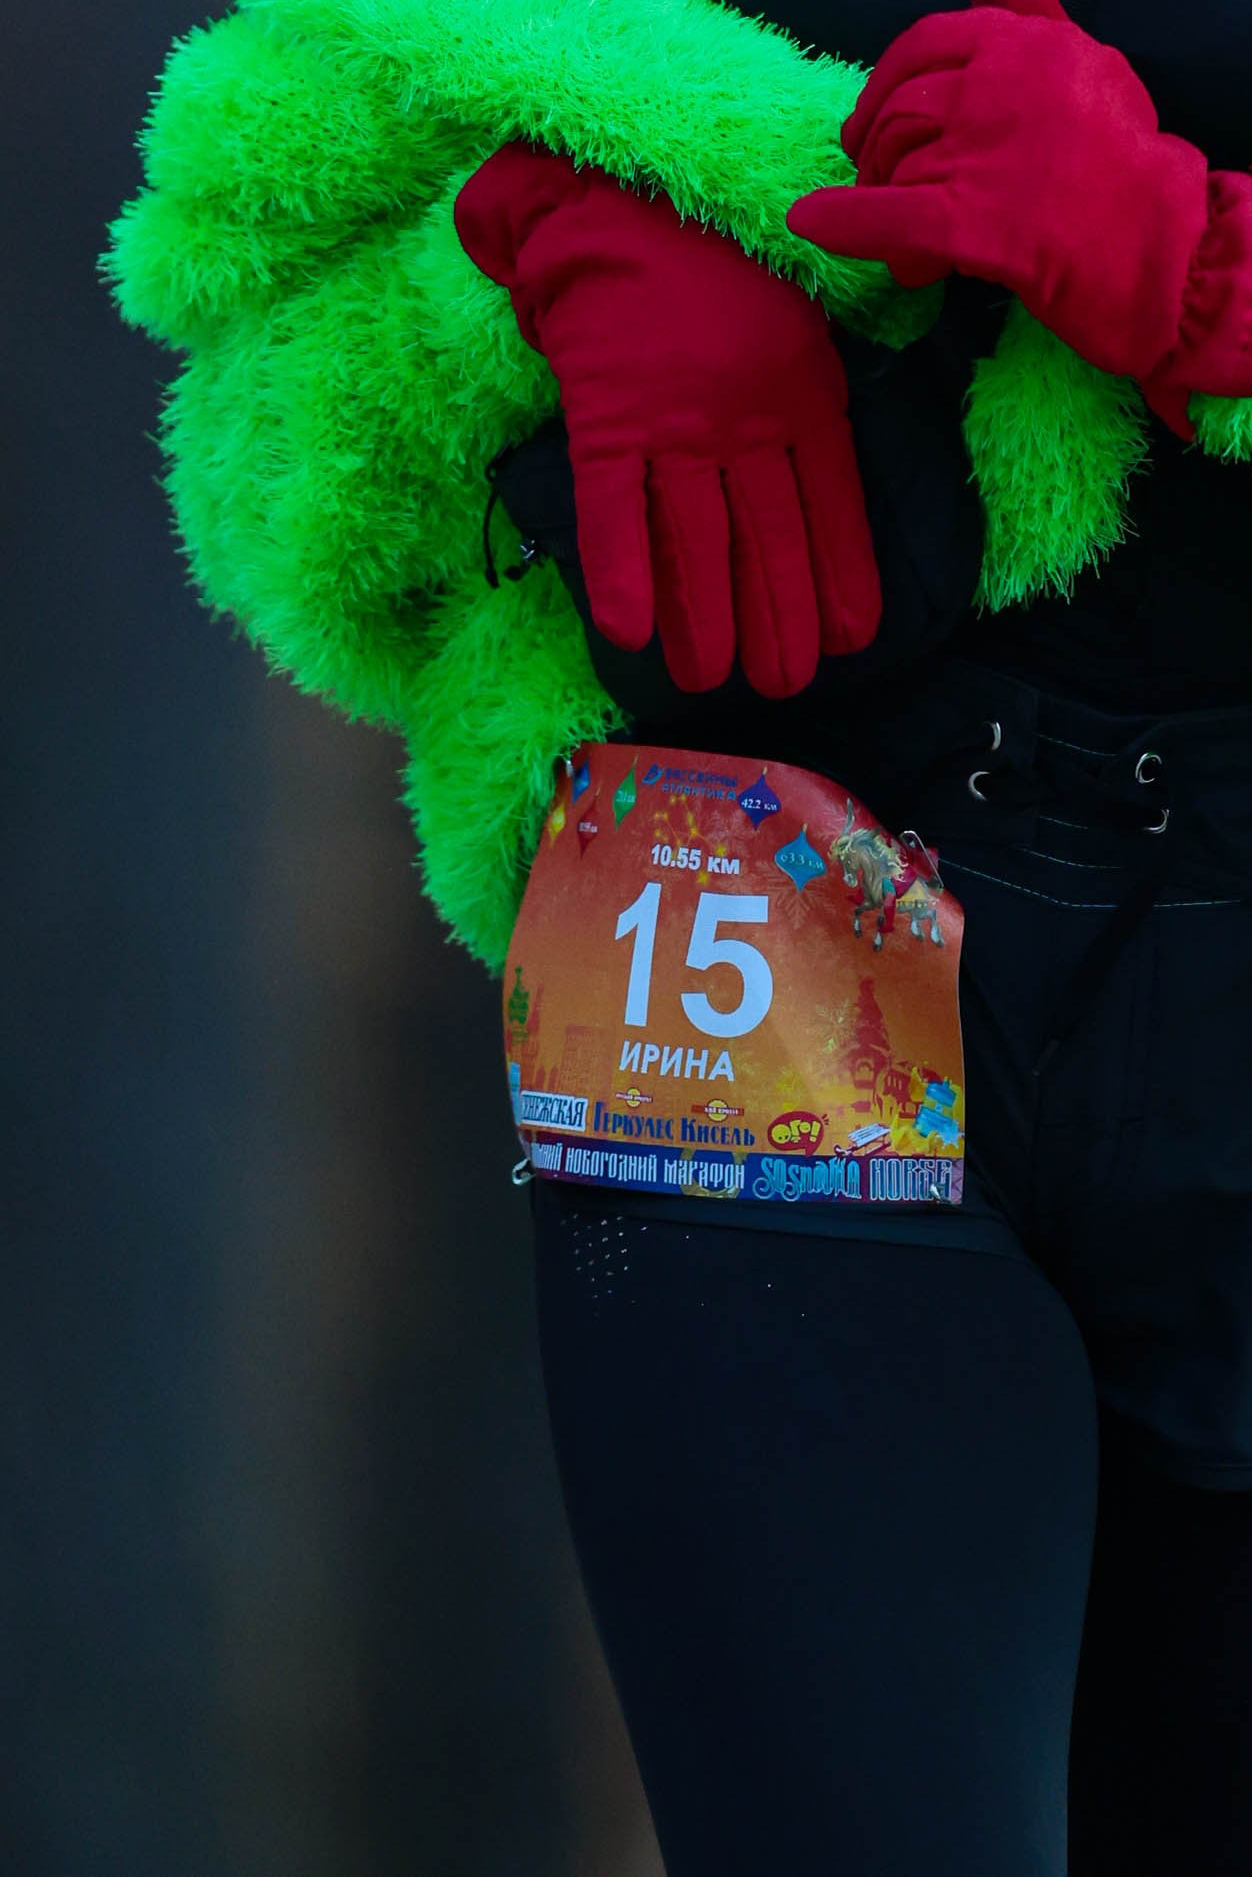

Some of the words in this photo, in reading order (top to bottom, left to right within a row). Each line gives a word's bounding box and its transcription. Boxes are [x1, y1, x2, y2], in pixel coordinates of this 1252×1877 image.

[740, 797, 761, 810] 42.2
[651, 843, 702, 871] 10.55
[614, 882, 773, 1039] 15
[619, 1040, 736, 1083] ИРИНА
[565, 1146, 658, 1183] НОВОГОДНИЙ
[663, 1158, 746, 1191] МАРАФОН
